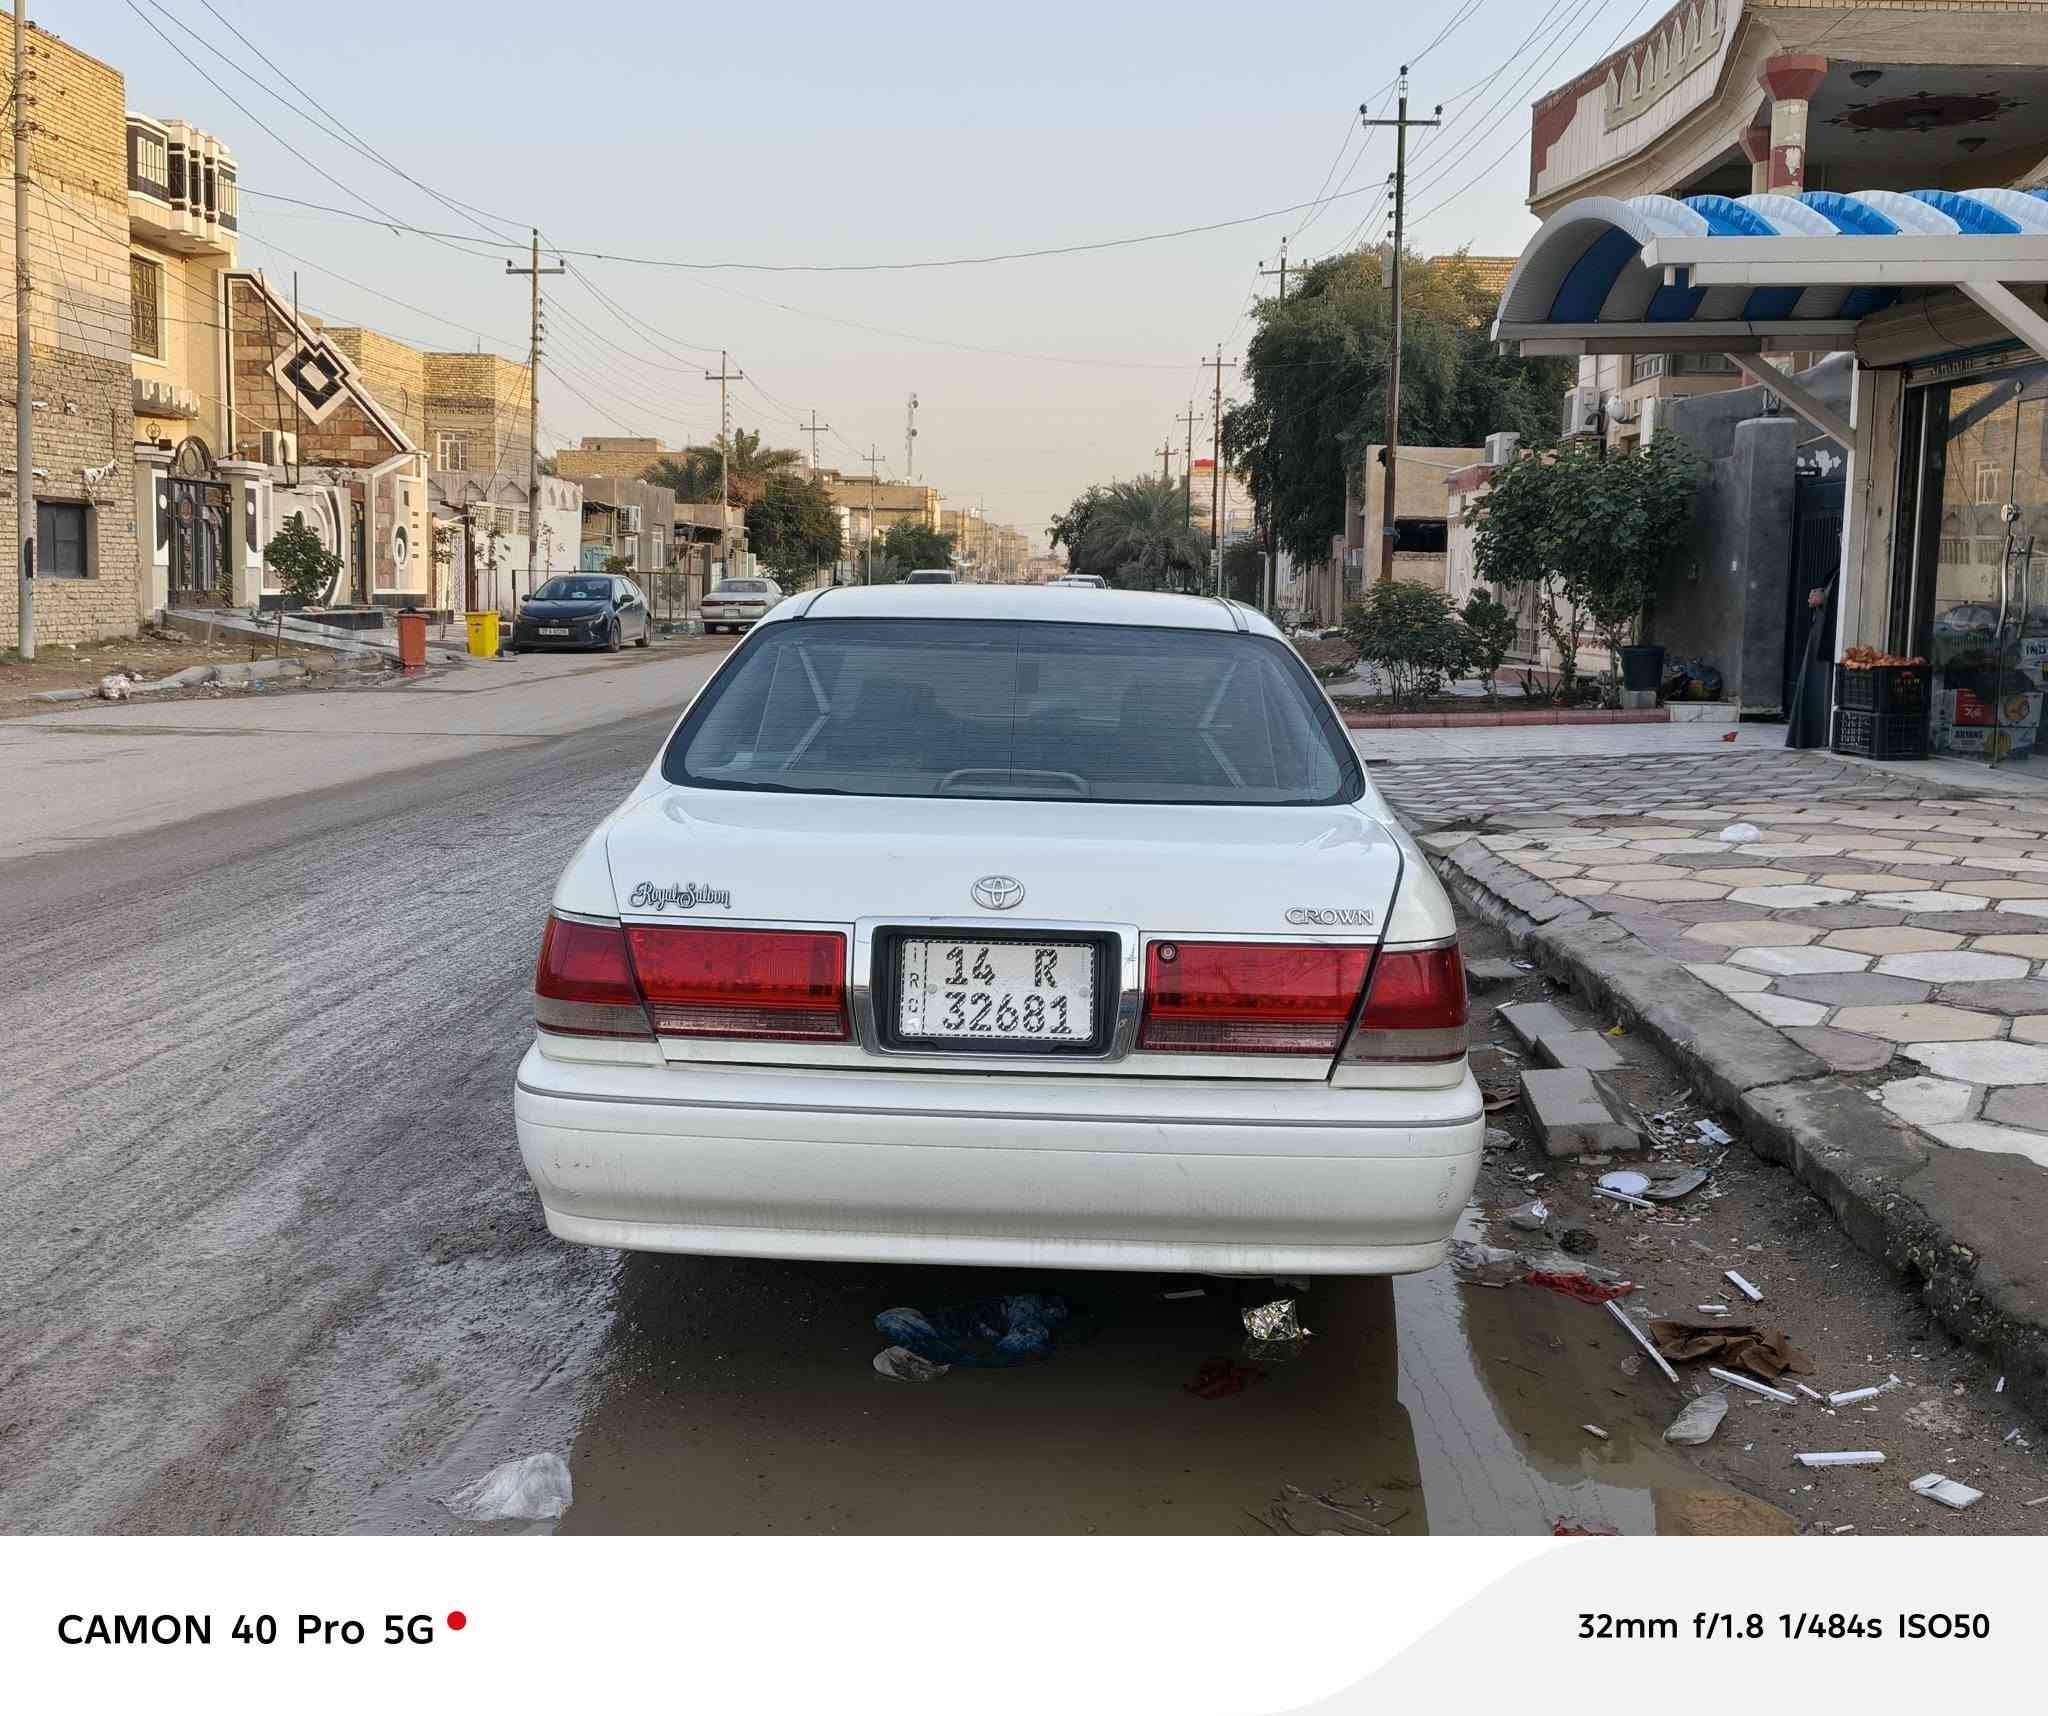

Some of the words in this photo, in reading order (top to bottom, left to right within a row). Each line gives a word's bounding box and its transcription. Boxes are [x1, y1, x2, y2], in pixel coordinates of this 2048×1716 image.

[629, 881, 678, 911] Royal
[677, 881, 732, 909] Saloon
[1285, 906, 1374, 926] CROWN
[945, 946, 995, 986] 14
[1034, 948, 1058, 989] R
[943, 991, 1072, 1035] 32681
